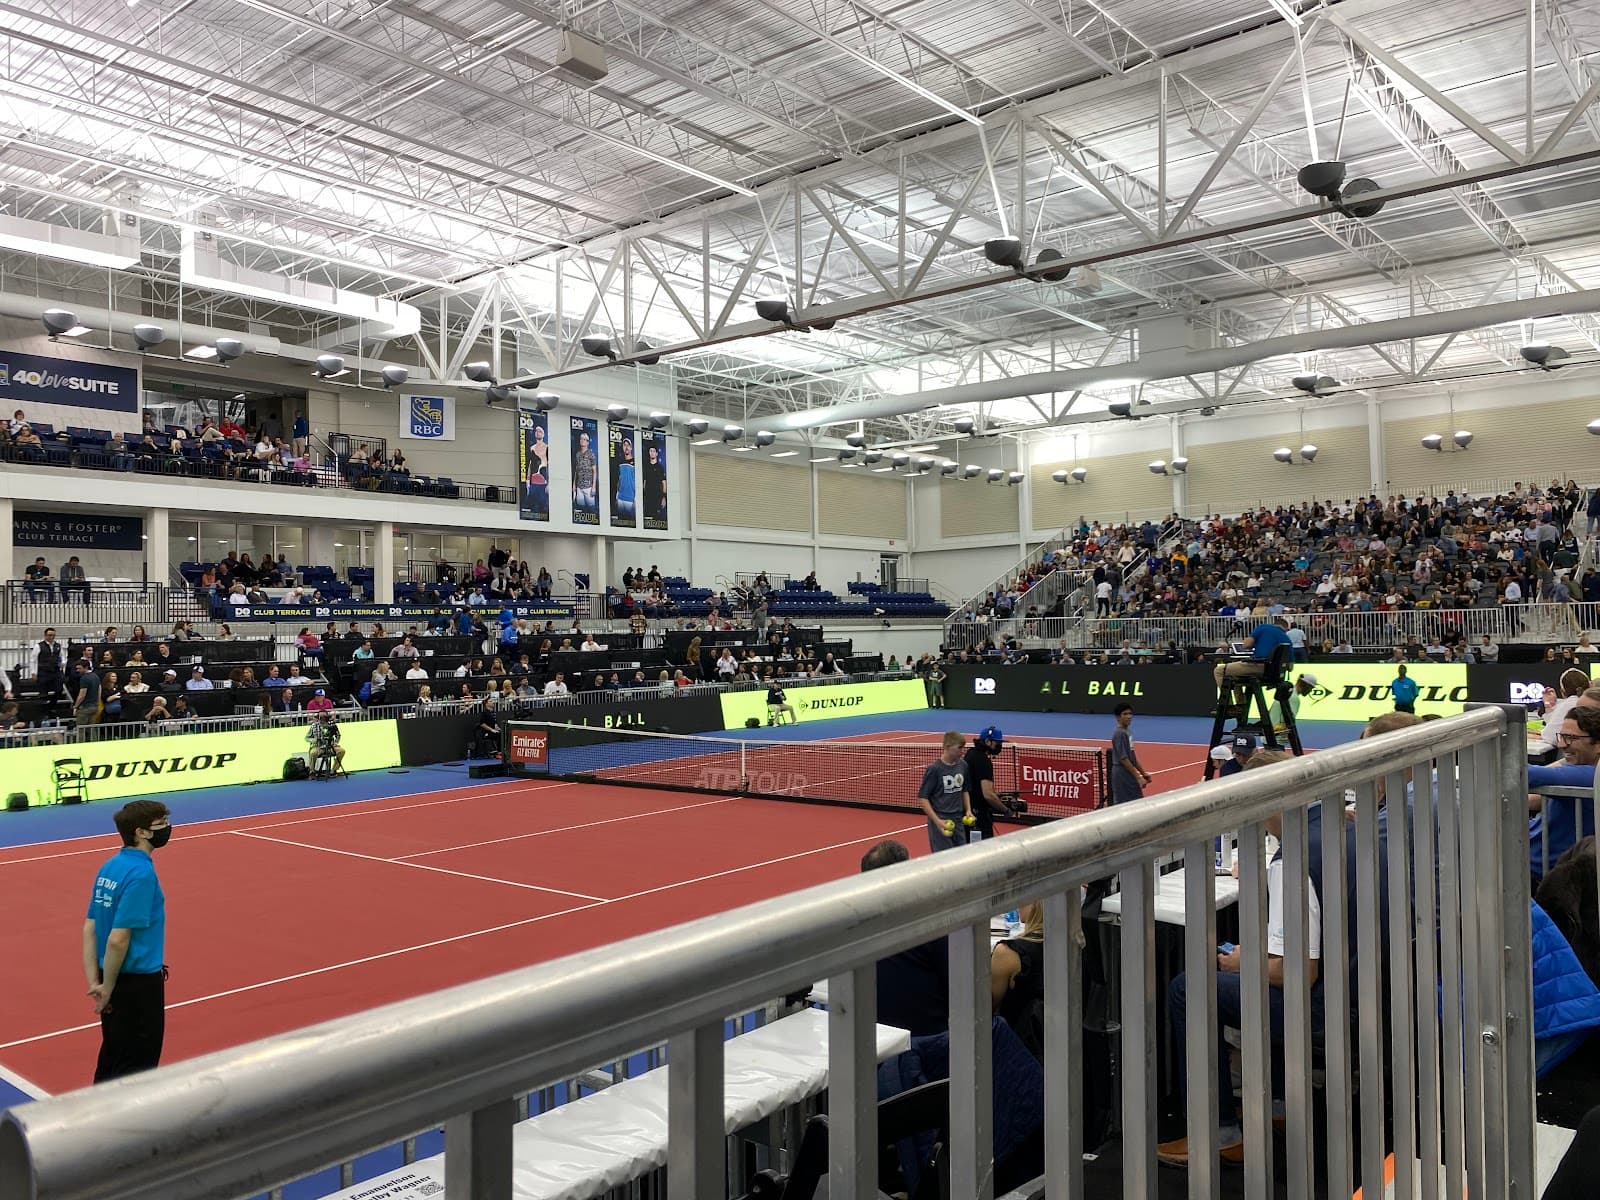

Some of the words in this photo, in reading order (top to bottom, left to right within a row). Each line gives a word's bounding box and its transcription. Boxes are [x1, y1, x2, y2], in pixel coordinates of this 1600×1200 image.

[413, 425, 441, 435] RBC
[573, 512, 598, 523] PAUL
[54, 522, 62, 531] &
[17, 532, 45, 541] CLUB
[49, 533, 95, 543] TERRACE
[1088, 681, 1144, 696] BALL
[811, 696, 864, 710] DUNLOP
[512, 735, 547, 748] Emirates
[87, 752, 237, 781] DUNLOP
[1023, 765, 1090, 785] Emirates
[1049, 784, 1079, 799] BETTER
[350, 1173, 416, 1200] Emanuelson
[391, 1175, 432, 1193] Wagner
